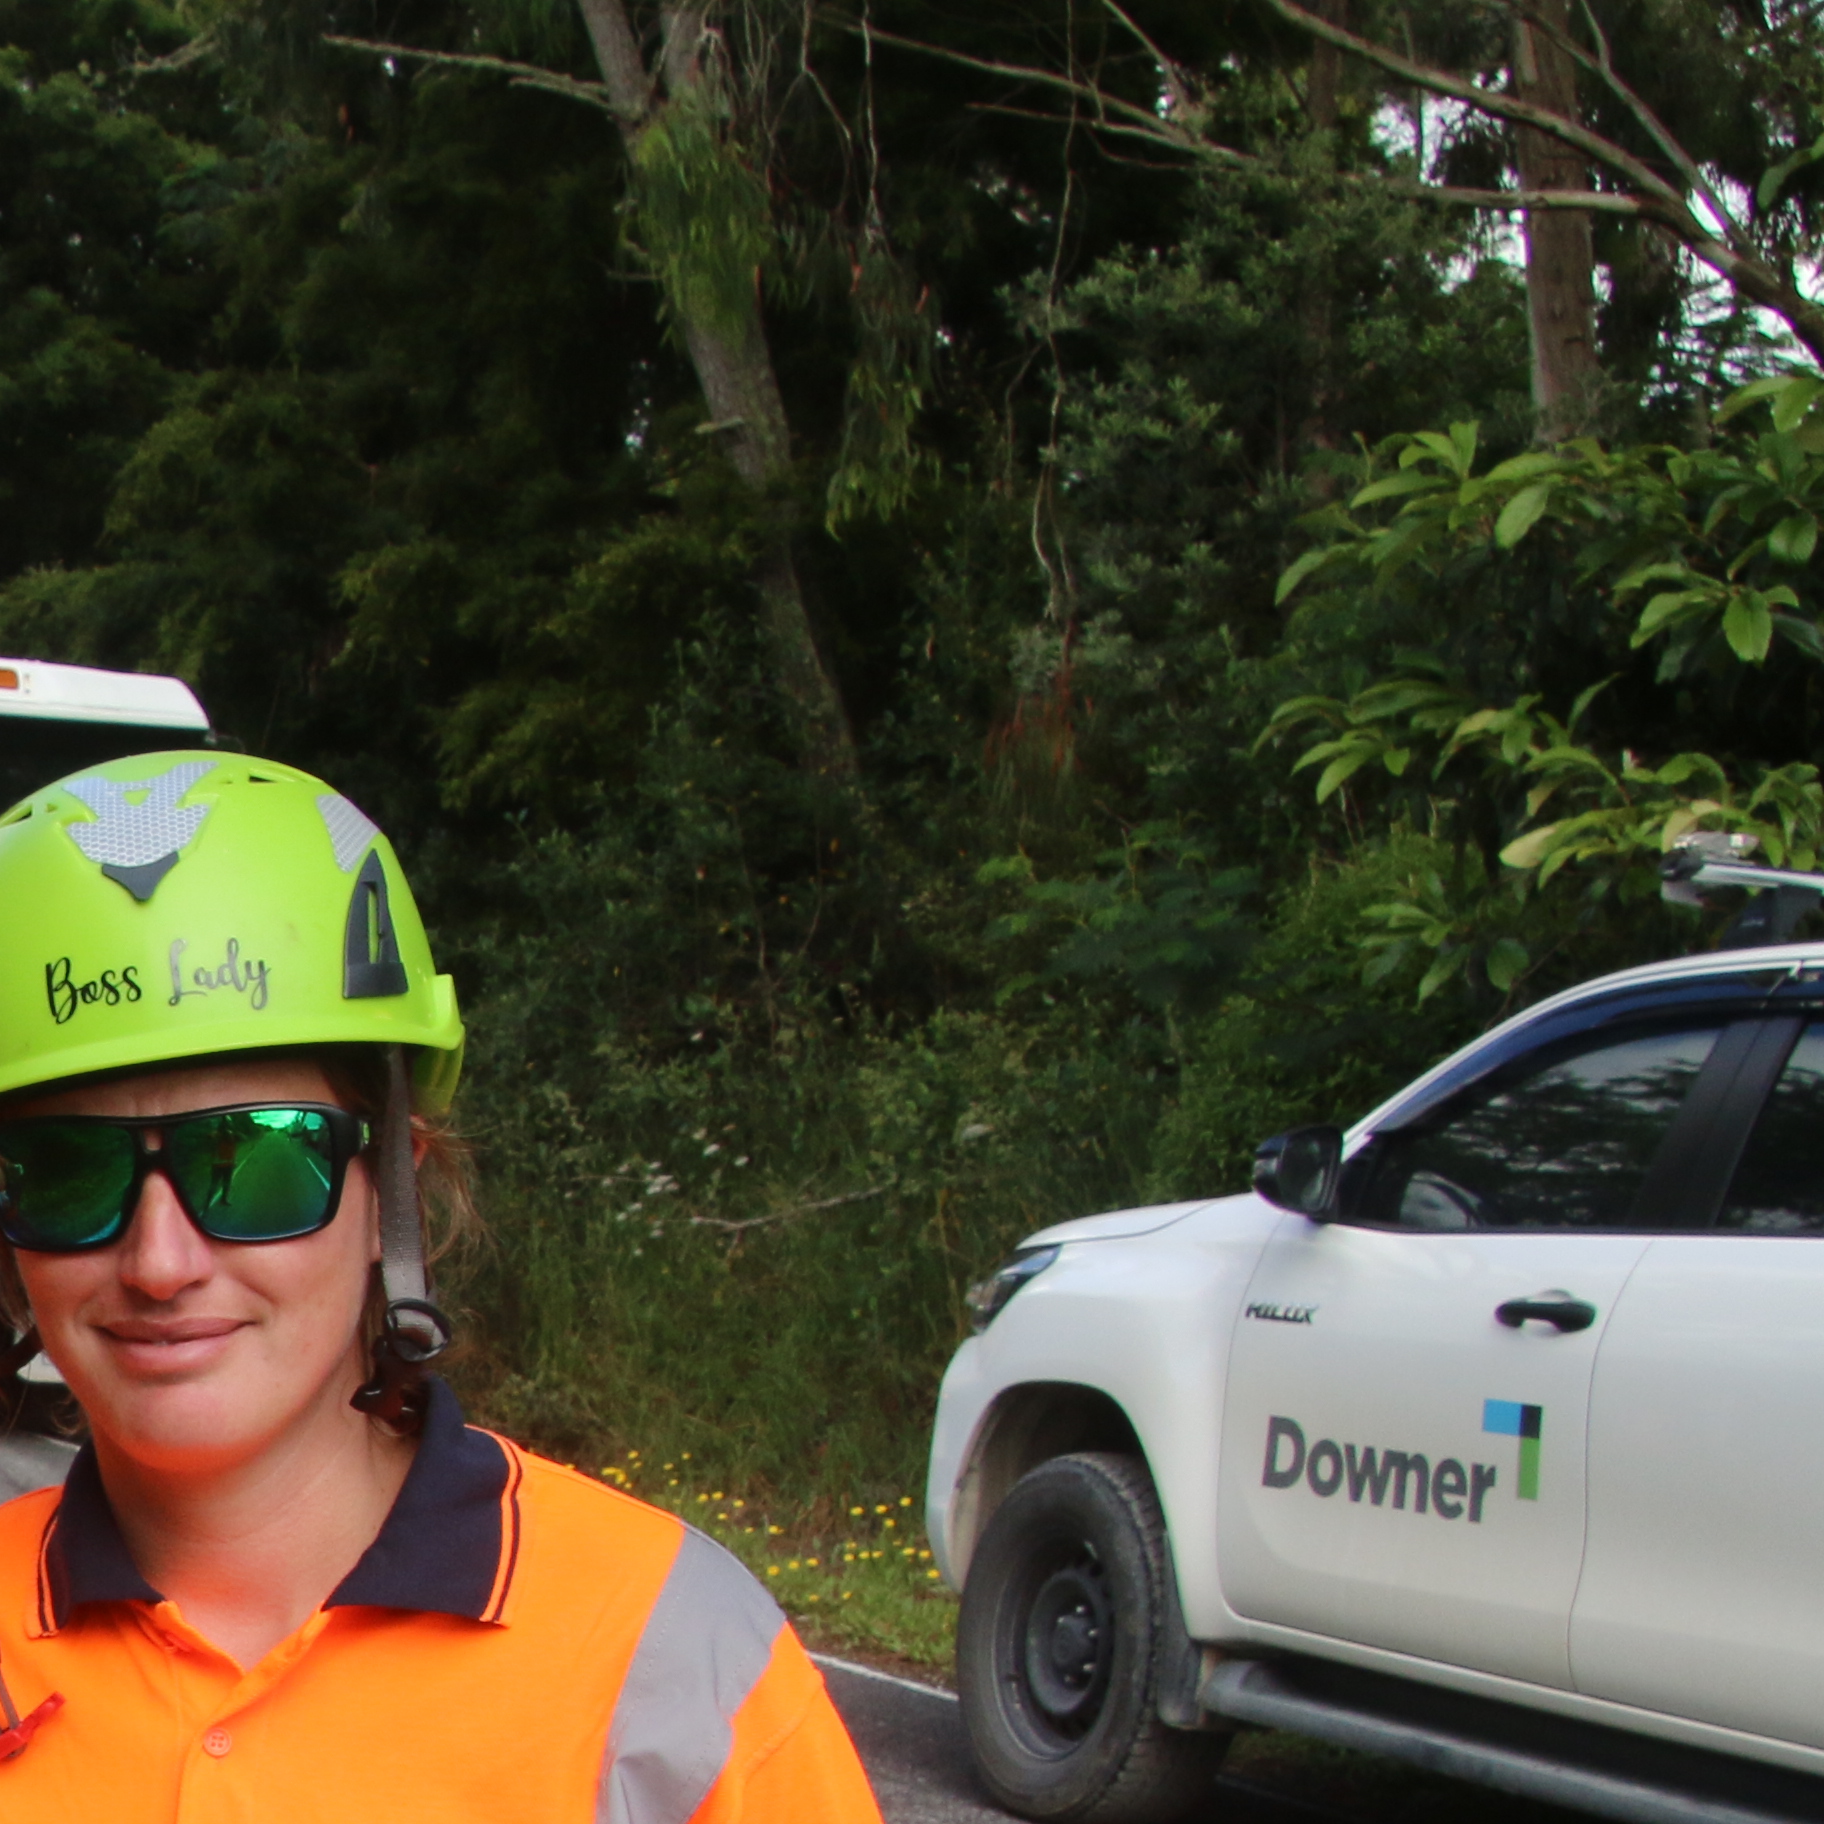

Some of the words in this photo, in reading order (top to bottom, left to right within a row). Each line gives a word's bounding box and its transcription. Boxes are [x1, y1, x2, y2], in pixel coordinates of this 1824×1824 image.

[46, 957, 143, 1025] Boss
[168, 937, 271, 1012] Lady
[1261, 1415, 1496, 1524] Downer
